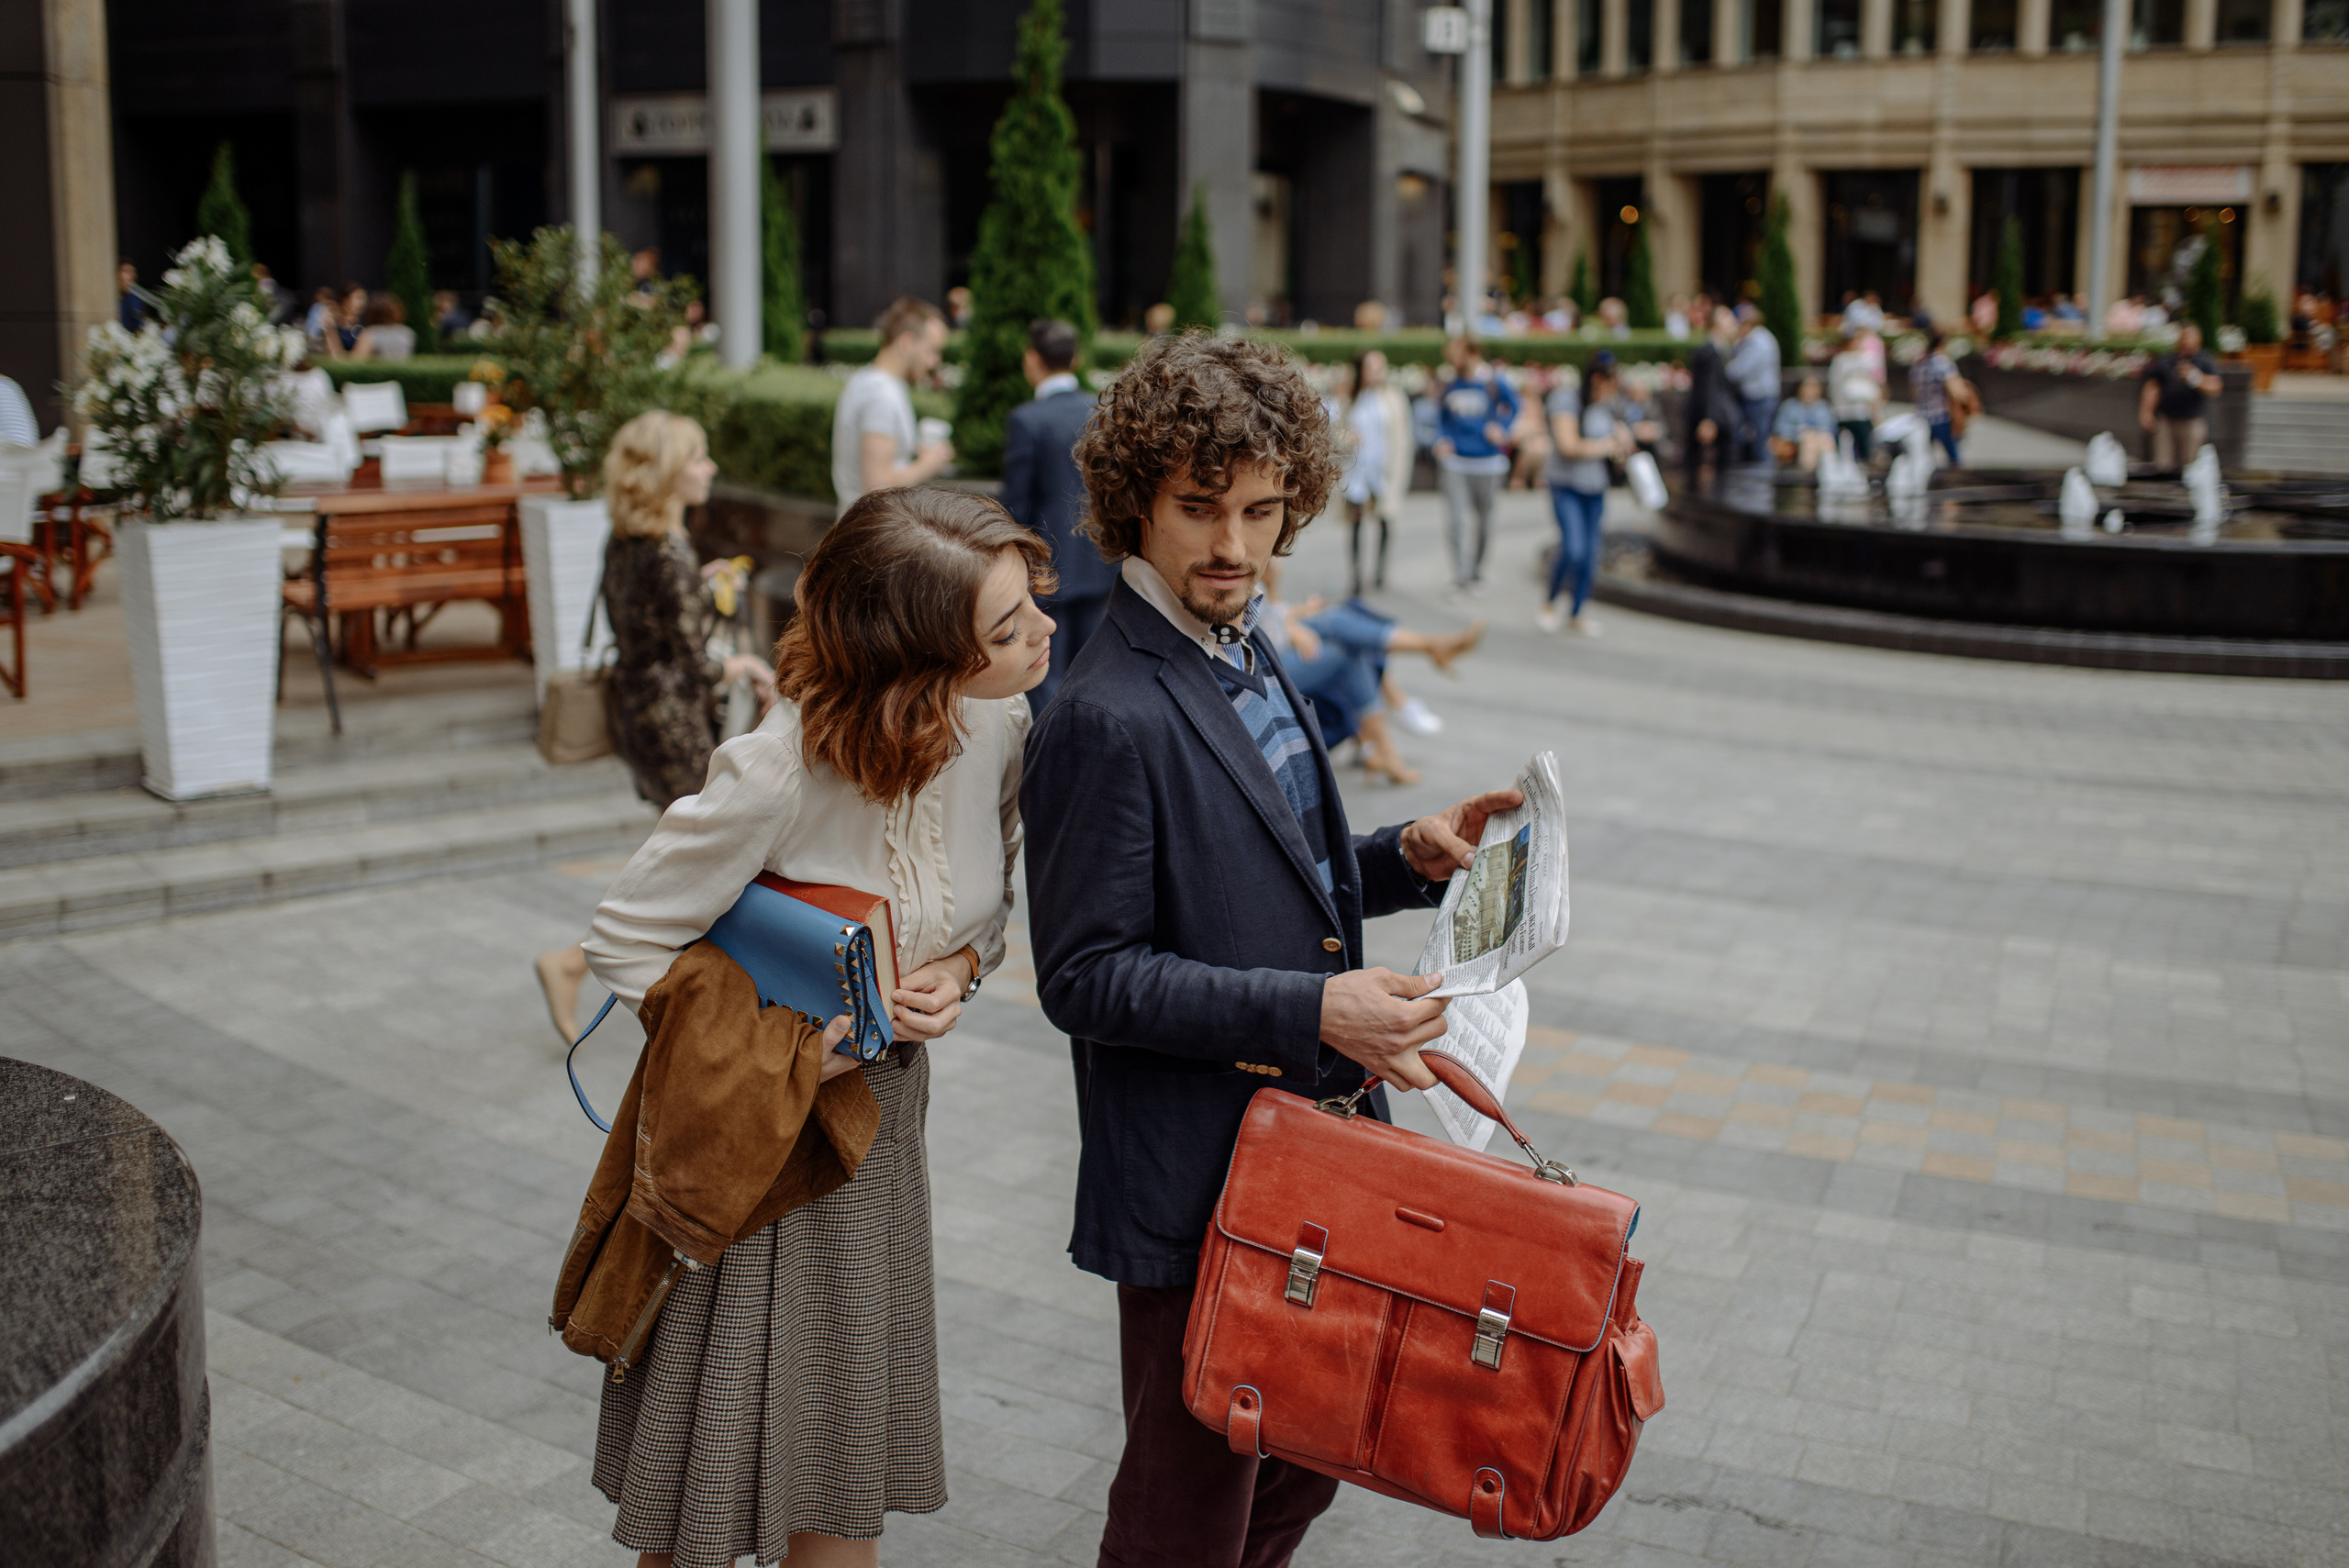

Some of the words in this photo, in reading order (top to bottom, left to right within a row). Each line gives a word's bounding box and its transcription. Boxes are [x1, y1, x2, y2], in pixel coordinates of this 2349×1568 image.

[1522, 775, 1538, 811] Finalists
[1532, 807, 1542, 836] Chosen
[1531, 845, 1541, 864] New
[1529, 862, 1539, 889] Duma
[1524, 886, 1538, 916] Design
[1520, 920, 1527, 932] To
[1528, 914, 1536, 936] IKEA
[1528, 933, 1536, 951] Mall
